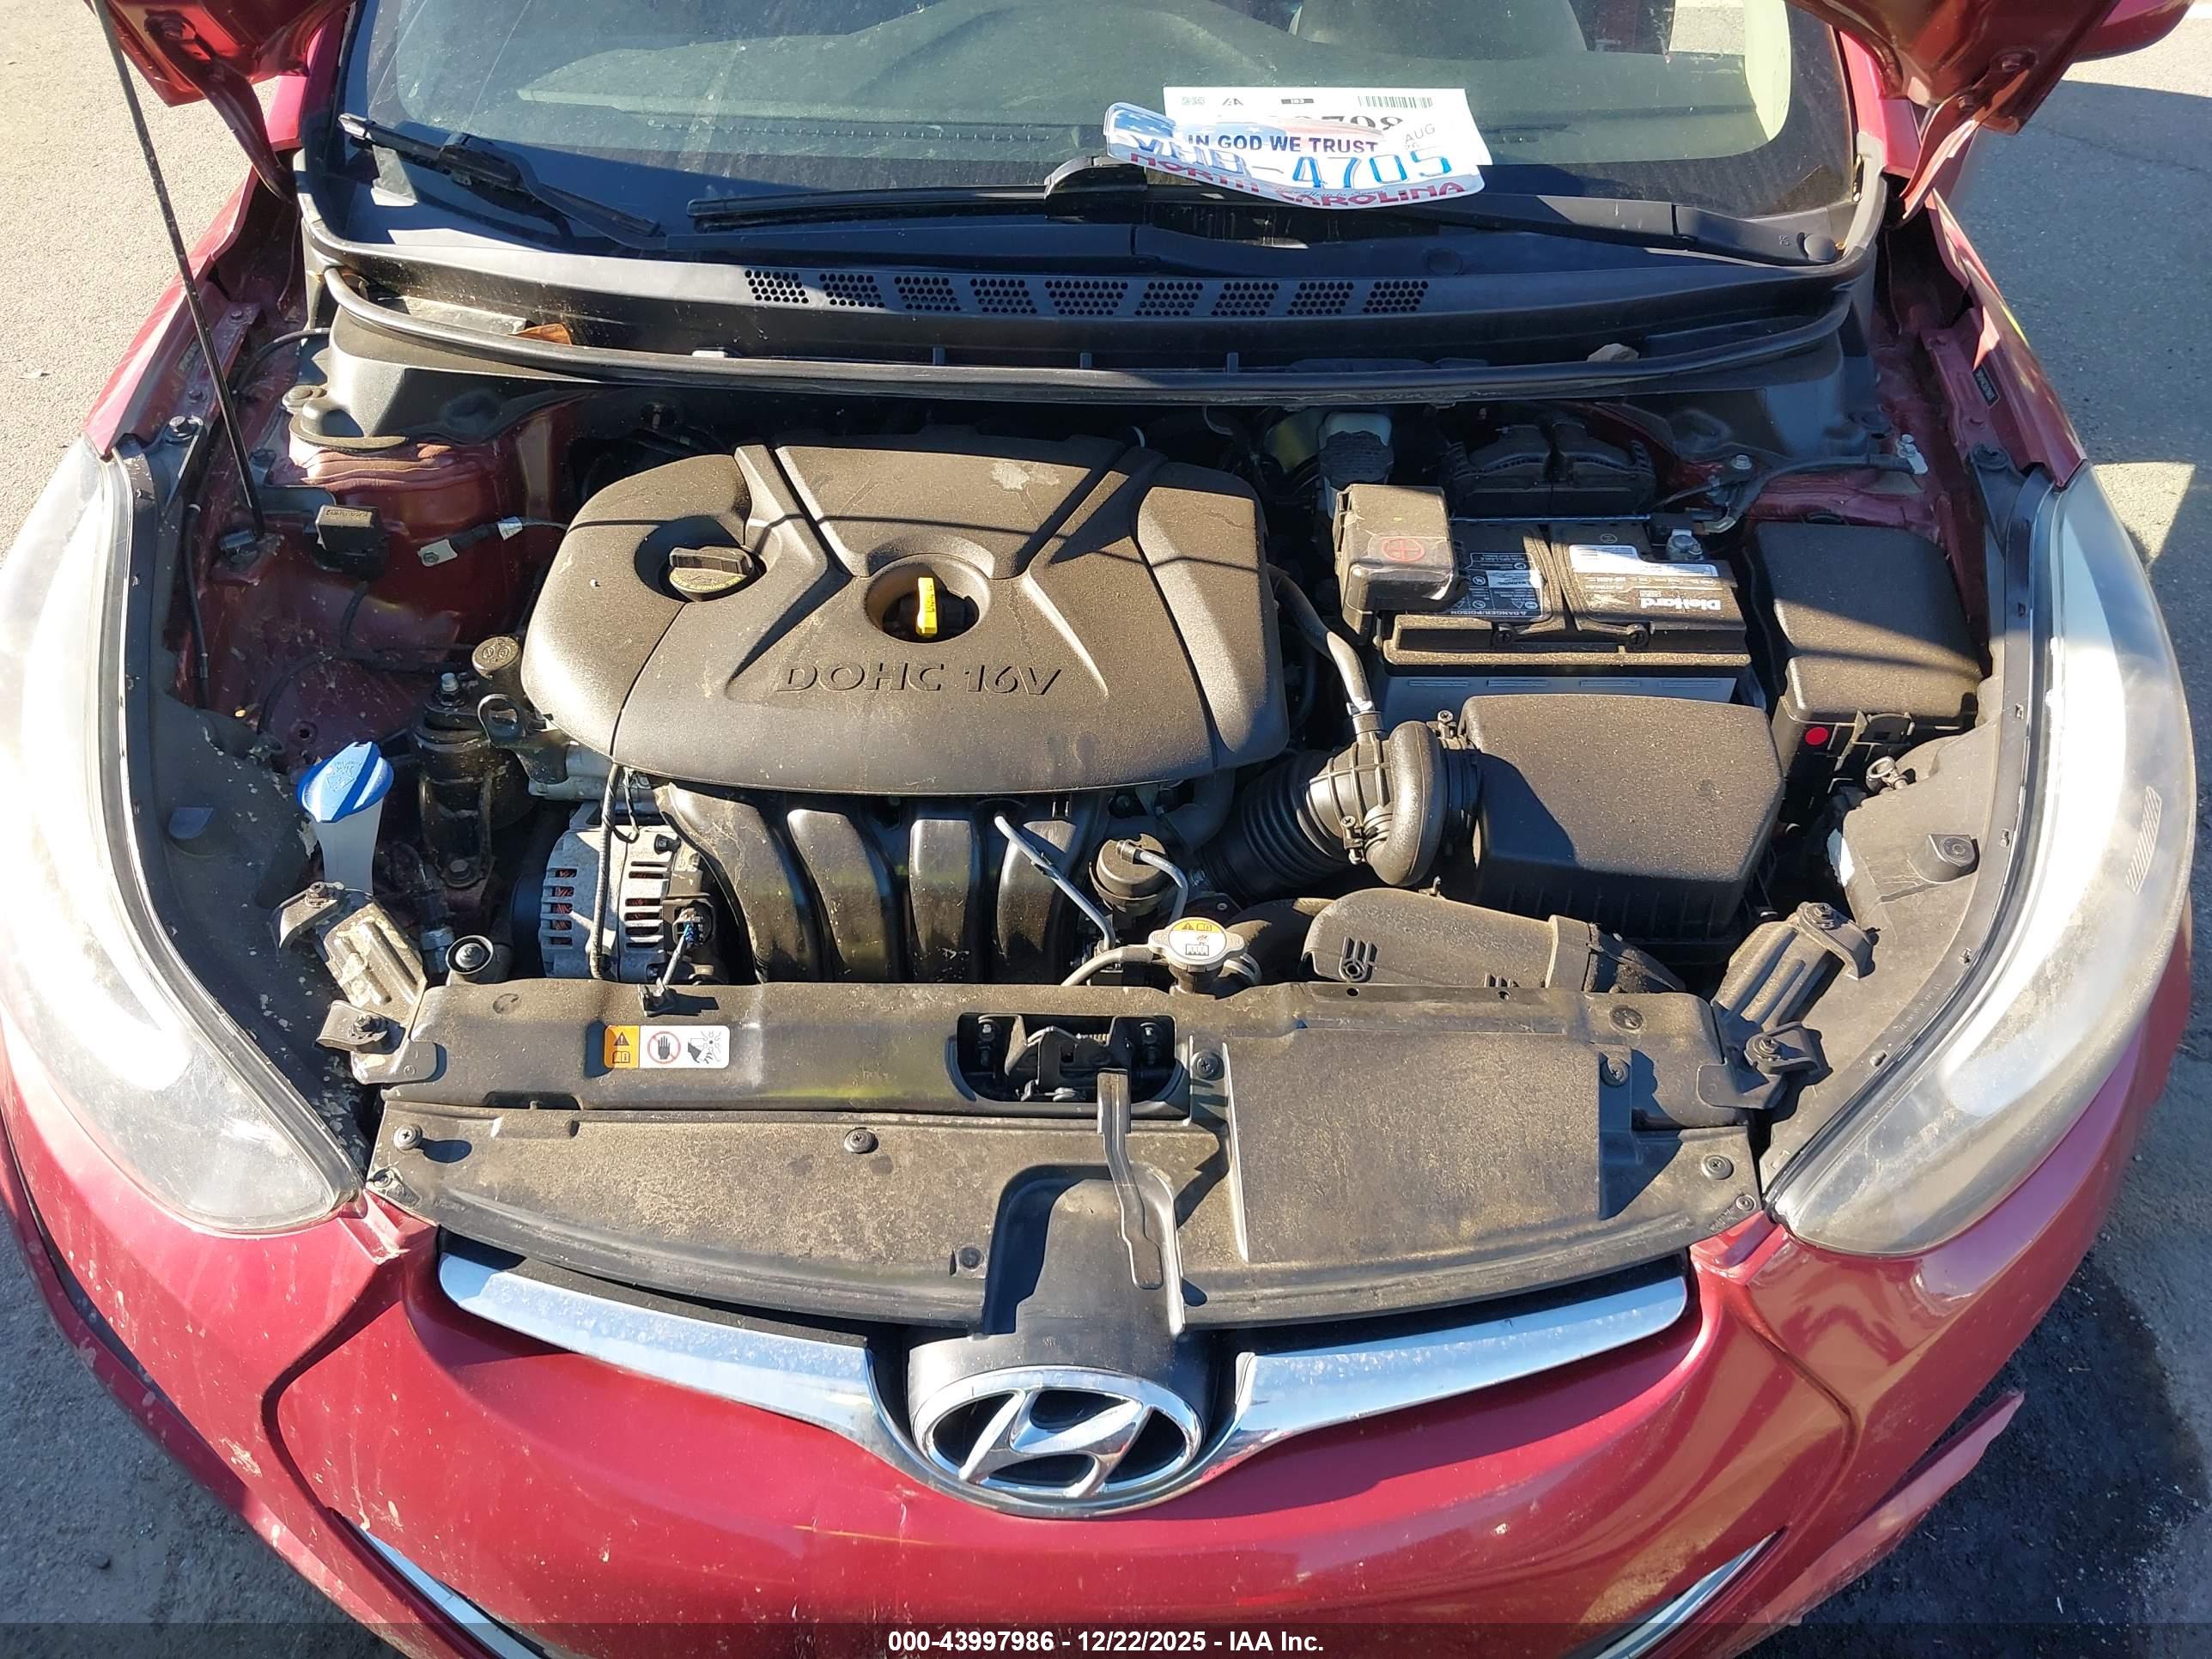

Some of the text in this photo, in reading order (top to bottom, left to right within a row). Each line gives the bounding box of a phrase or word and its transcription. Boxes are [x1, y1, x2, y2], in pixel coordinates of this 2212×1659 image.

[1188, 134, 1379, 154] IN GOD WE TRUST
[1404, 123, 1436, 144] AUG
[1278, 181, 1466, 207] CAROLINA
[1640, 597, 1722, 611] DieHard
[776, 662, 1063, 696] DOHC 16V
